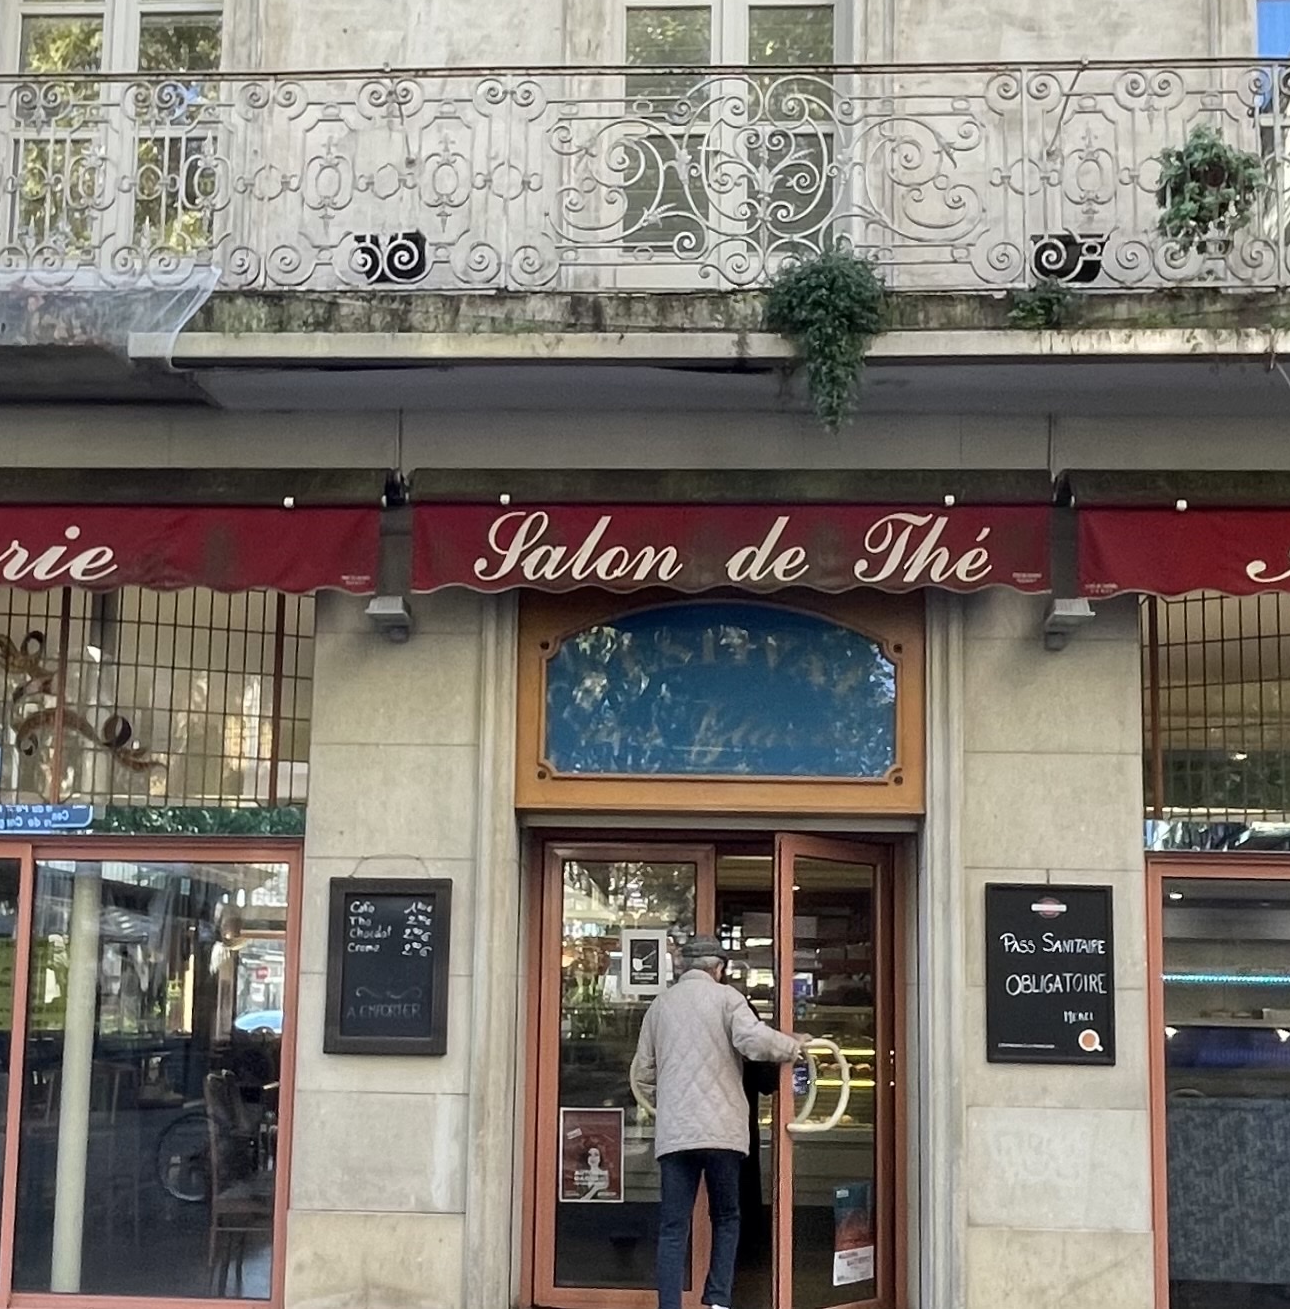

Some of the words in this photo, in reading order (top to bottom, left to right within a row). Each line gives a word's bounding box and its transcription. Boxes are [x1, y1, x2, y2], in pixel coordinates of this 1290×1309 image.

[473, 511, 683, 581] Salon
[726, 516, 809, 582] de
[853, 513, 992, 583] Thé
[1005, 972, 1108, 996] OBLIGATOIRE
